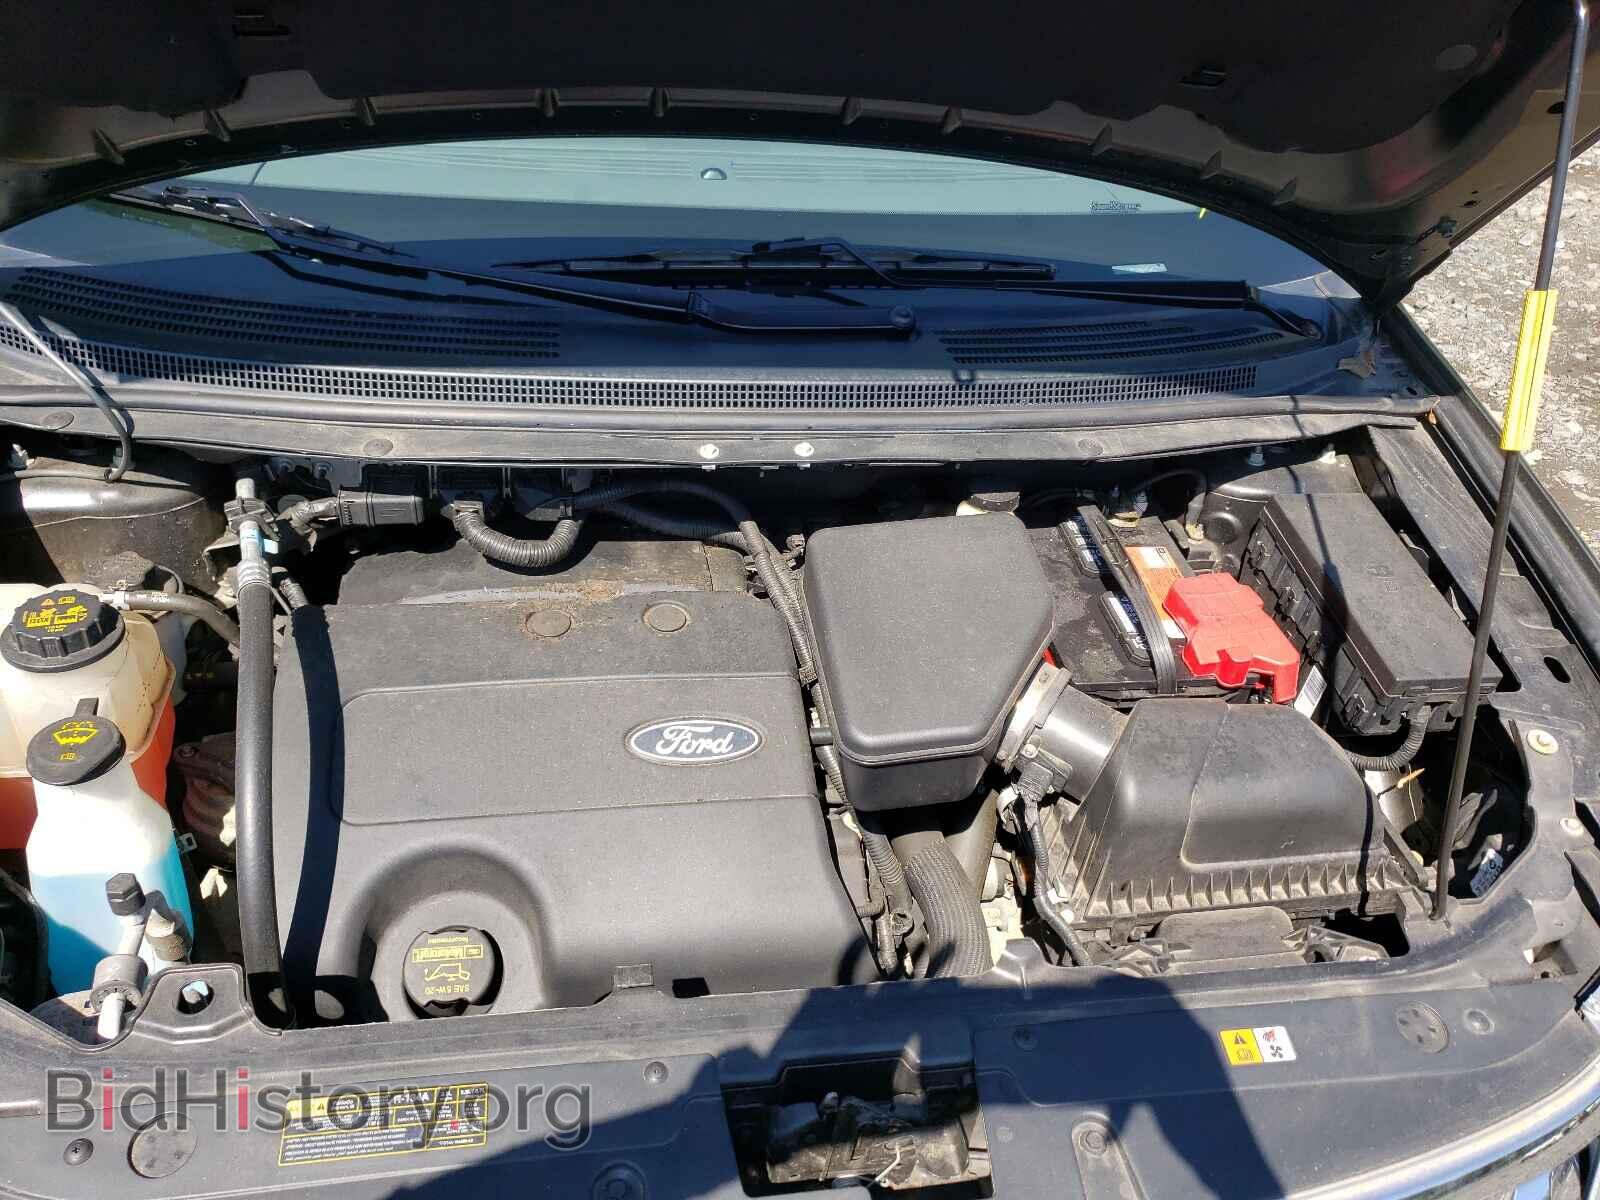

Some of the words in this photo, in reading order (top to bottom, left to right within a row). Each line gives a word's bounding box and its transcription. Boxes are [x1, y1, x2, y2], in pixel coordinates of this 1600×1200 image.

[656, 725, 735, 755] Ford
[424, 985, 452, 995] 5W-20
[453, 984, 470, 993] SAE
